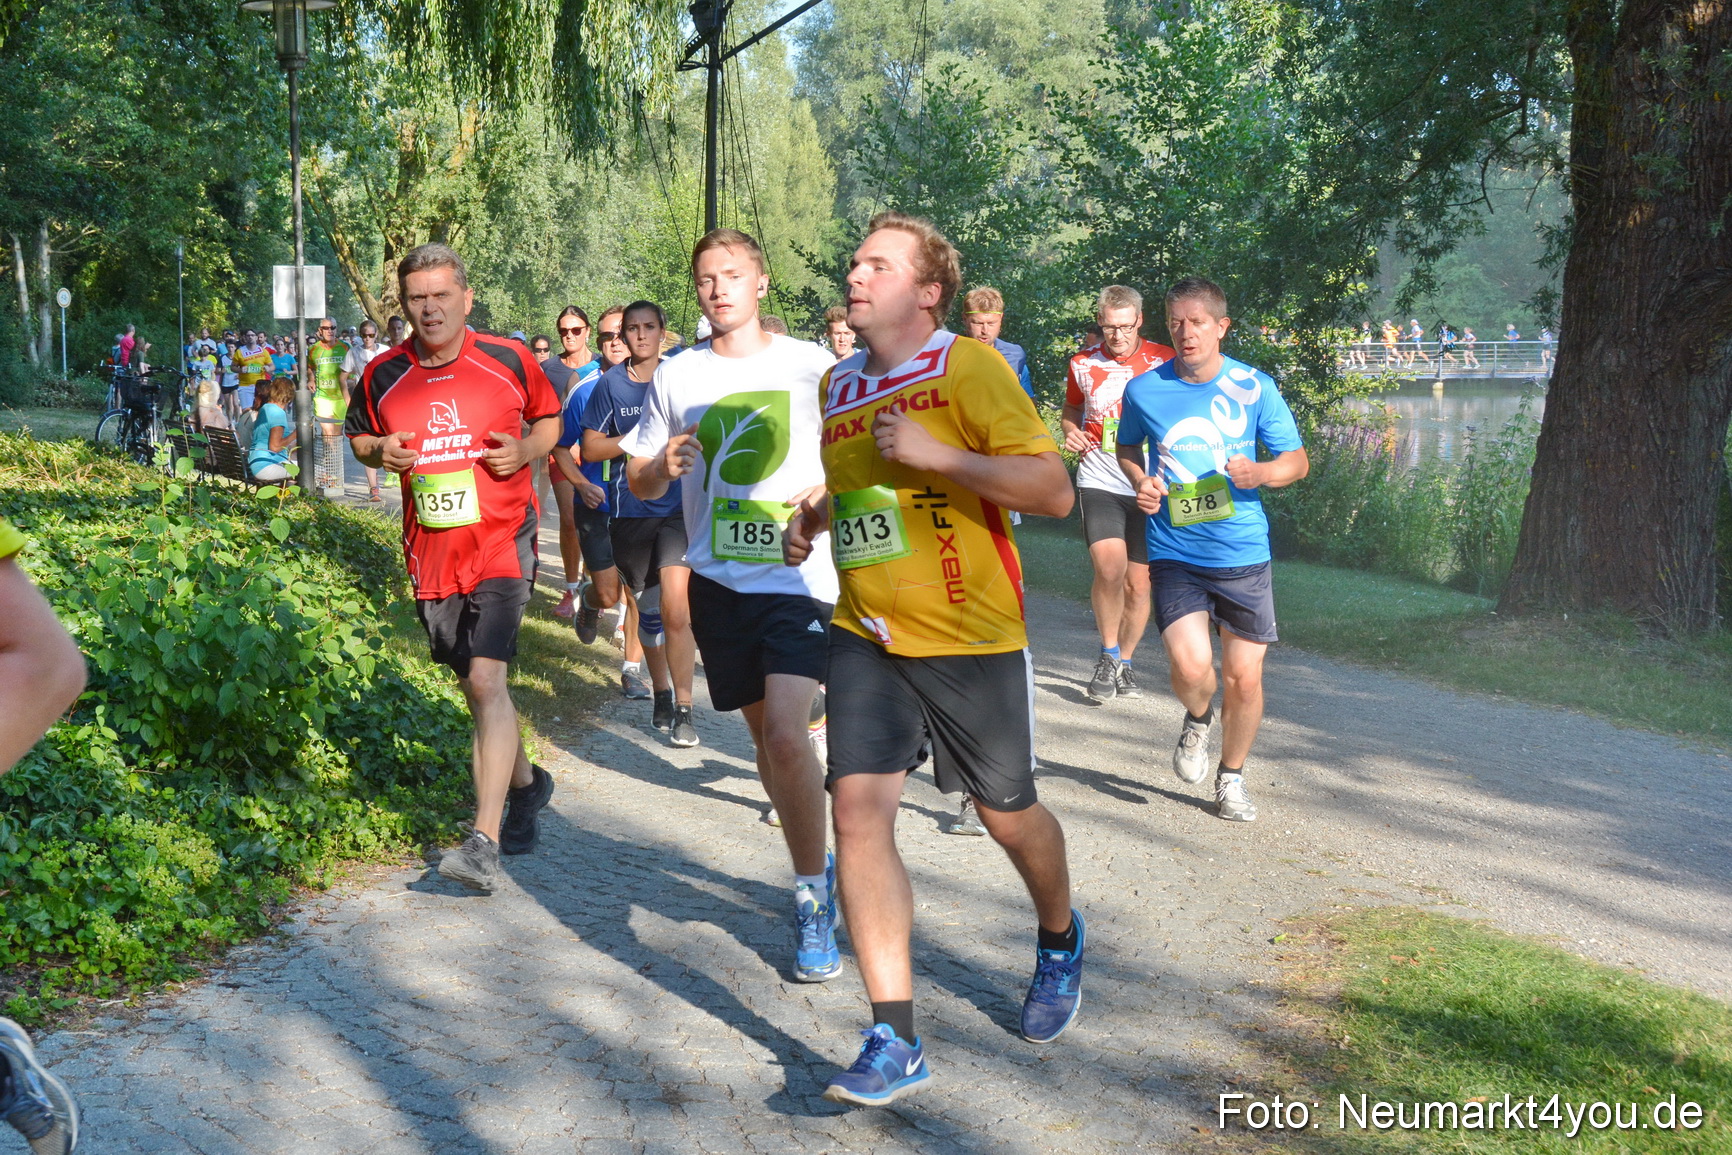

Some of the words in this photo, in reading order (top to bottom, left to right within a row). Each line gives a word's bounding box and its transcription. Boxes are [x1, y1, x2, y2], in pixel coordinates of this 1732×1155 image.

[427, 374, 455, 384] STANNO
[822, 415, 867, 449] MAX
[421, 433, 473, 453] MEYER
[1172, 442, 1208, 452] anders
[1210, 441, 1225, 451] als
[1226, 440, 1256, 451] andere
[417, 490, 467, 513] 1357
[1179, 493, 1218, 514] 378
[729, 521, 775, 546] 185
[834, 513, 891, 548] 1313
[722, 543, 759, 553] Oppermann
[759, 545, 781, 554] Simon
[869, 540, 893, 551] Ewald
